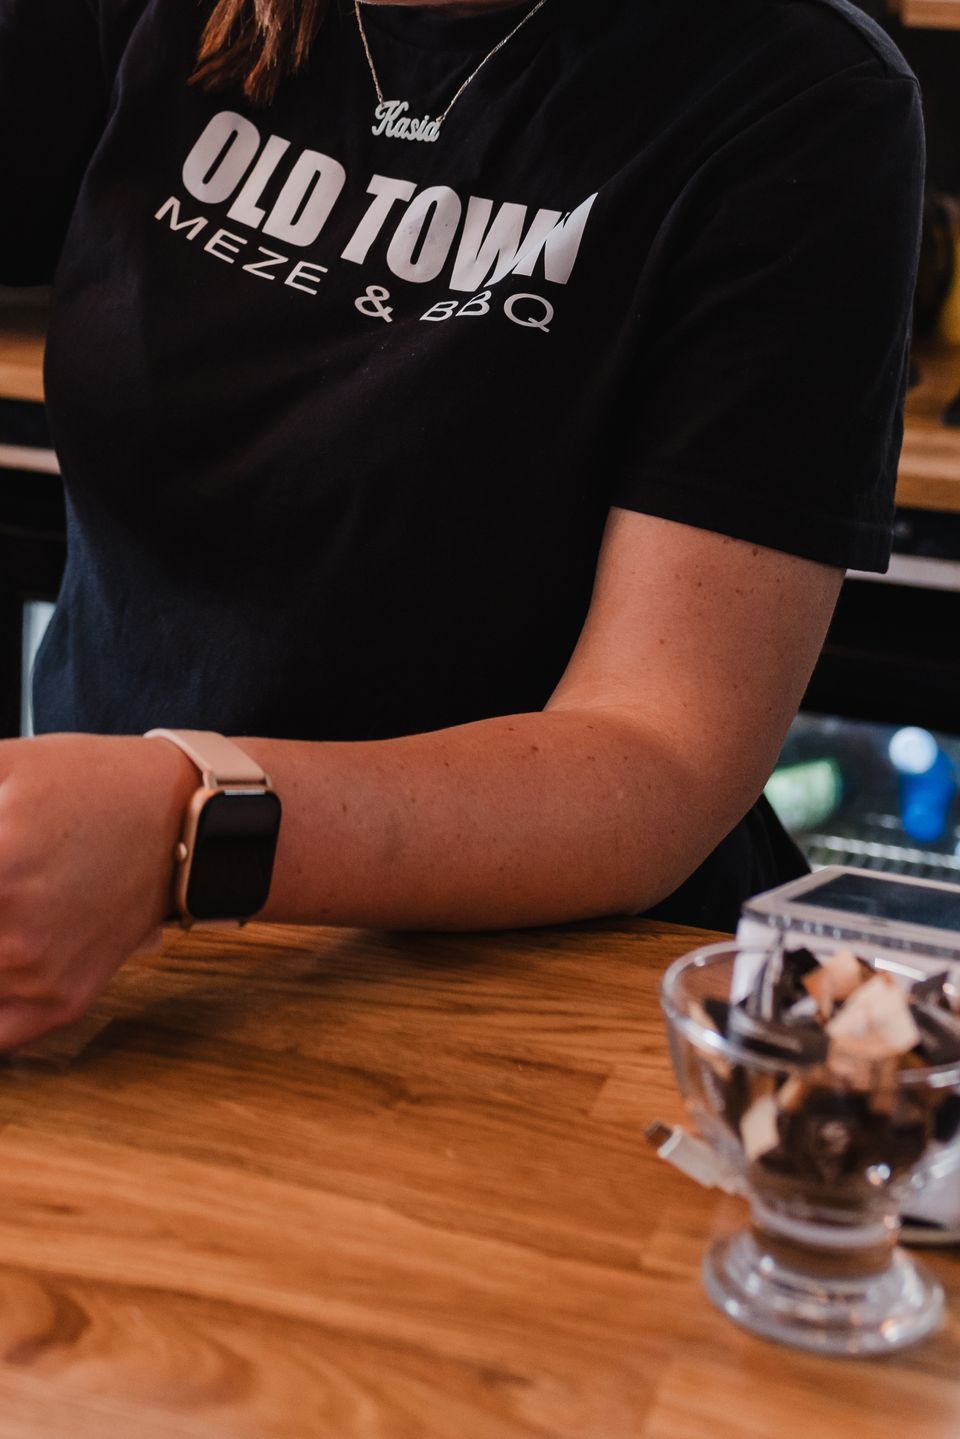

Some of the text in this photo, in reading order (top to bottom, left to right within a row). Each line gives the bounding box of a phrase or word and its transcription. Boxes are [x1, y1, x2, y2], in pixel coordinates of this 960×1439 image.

[372, 100, 441, 142] Kasia
[154, 196, 555, 333] MEZE & BBQ
[182, 110, 598, 292] OLD TOWN
